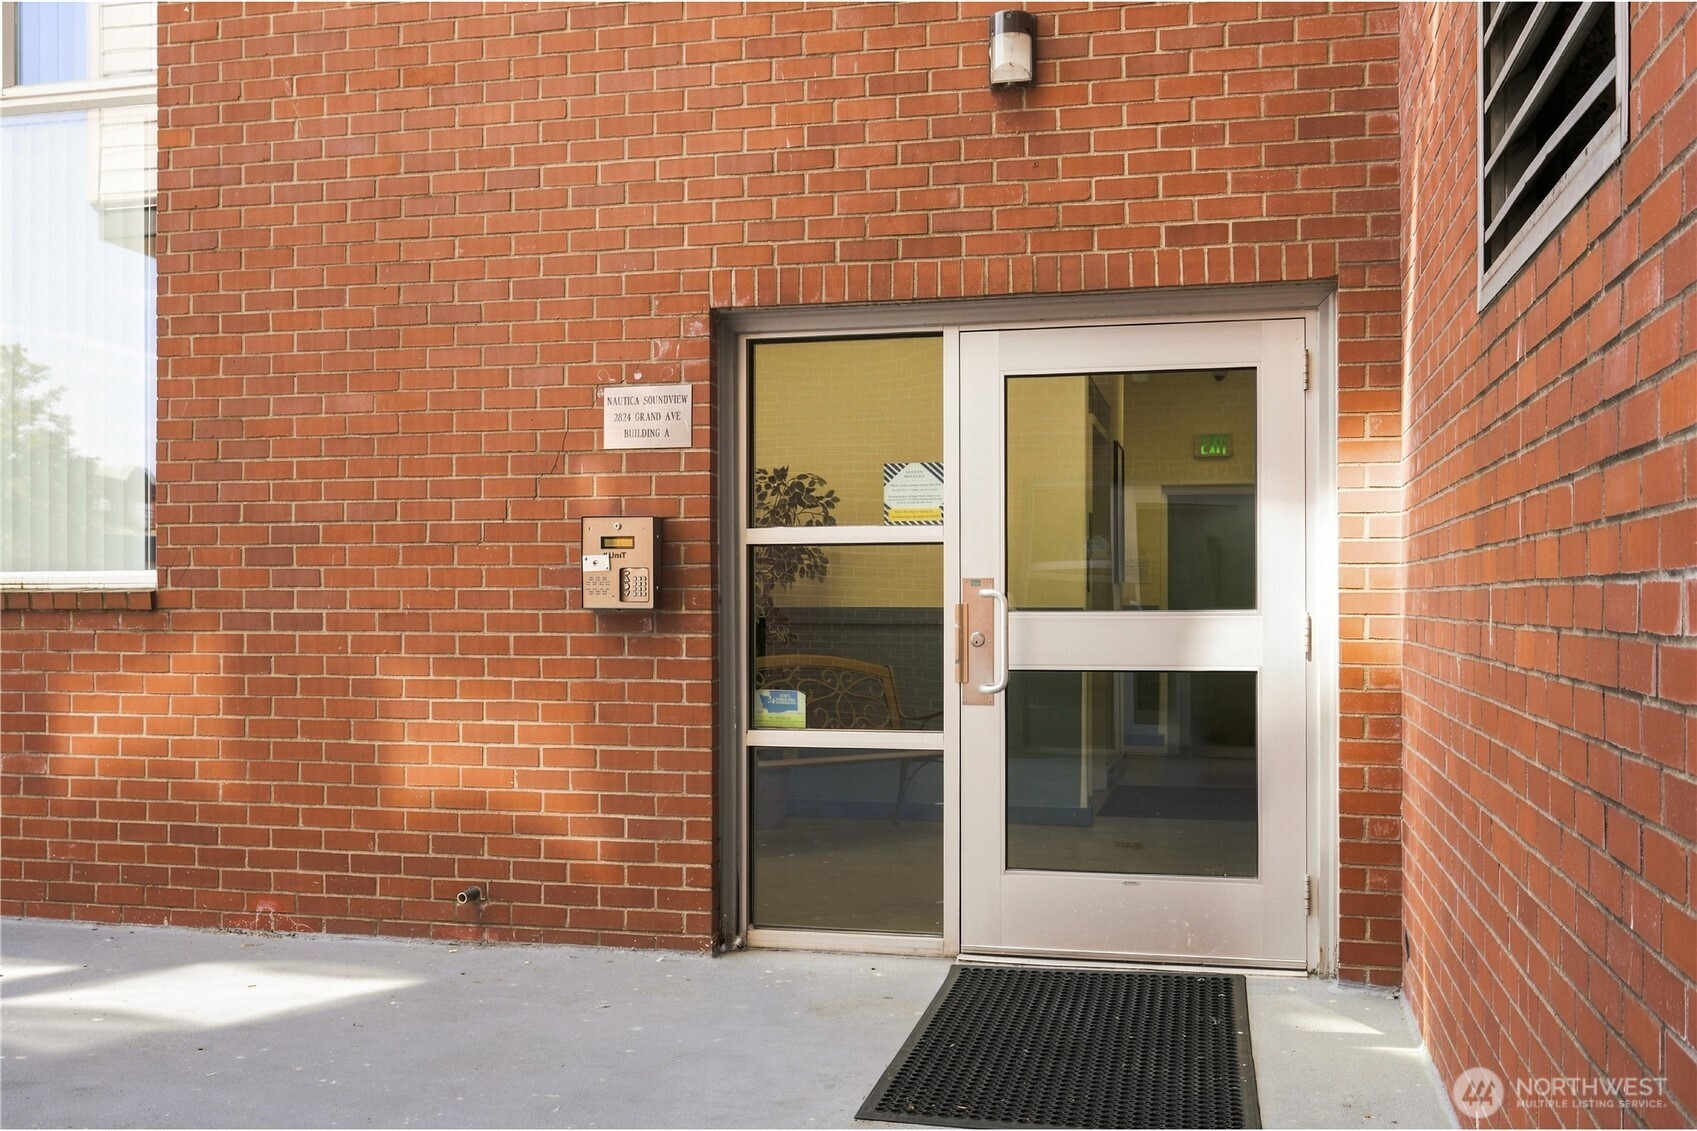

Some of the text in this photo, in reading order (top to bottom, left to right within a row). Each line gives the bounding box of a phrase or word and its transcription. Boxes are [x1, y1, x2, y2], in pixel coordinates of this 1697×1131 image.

[606, 395, 689, 406] NAUTICA SOUNDVIEW
[613, 411, 682, 422] 2824 GRAND AVE
[624, 428, 670, 438] BUILDING A
